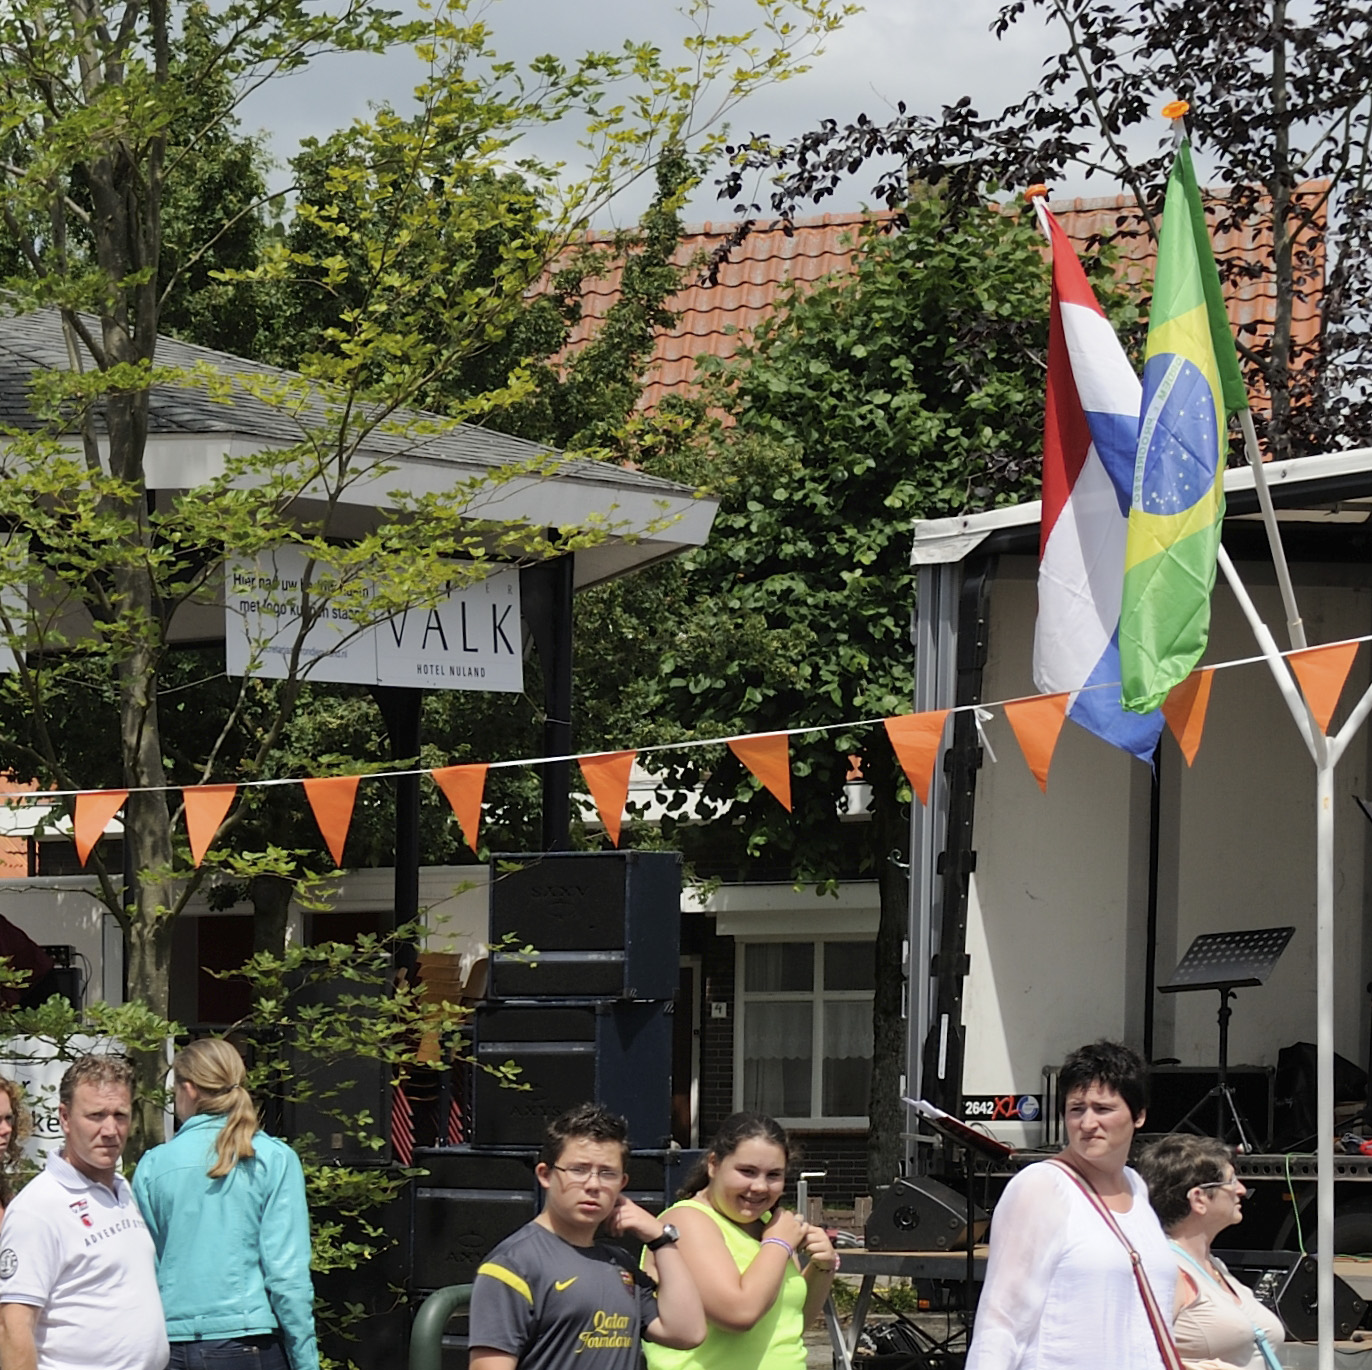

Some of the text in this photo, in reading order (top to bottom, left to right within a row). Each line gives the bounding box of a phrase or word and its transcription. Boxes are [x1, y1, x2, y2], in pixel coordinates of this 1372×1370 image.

[387, 601, 515, 655] VALK
[416, 664, 486, 678] HOTEL NULAND
[593, 1310, 630, 1334] Qatar
